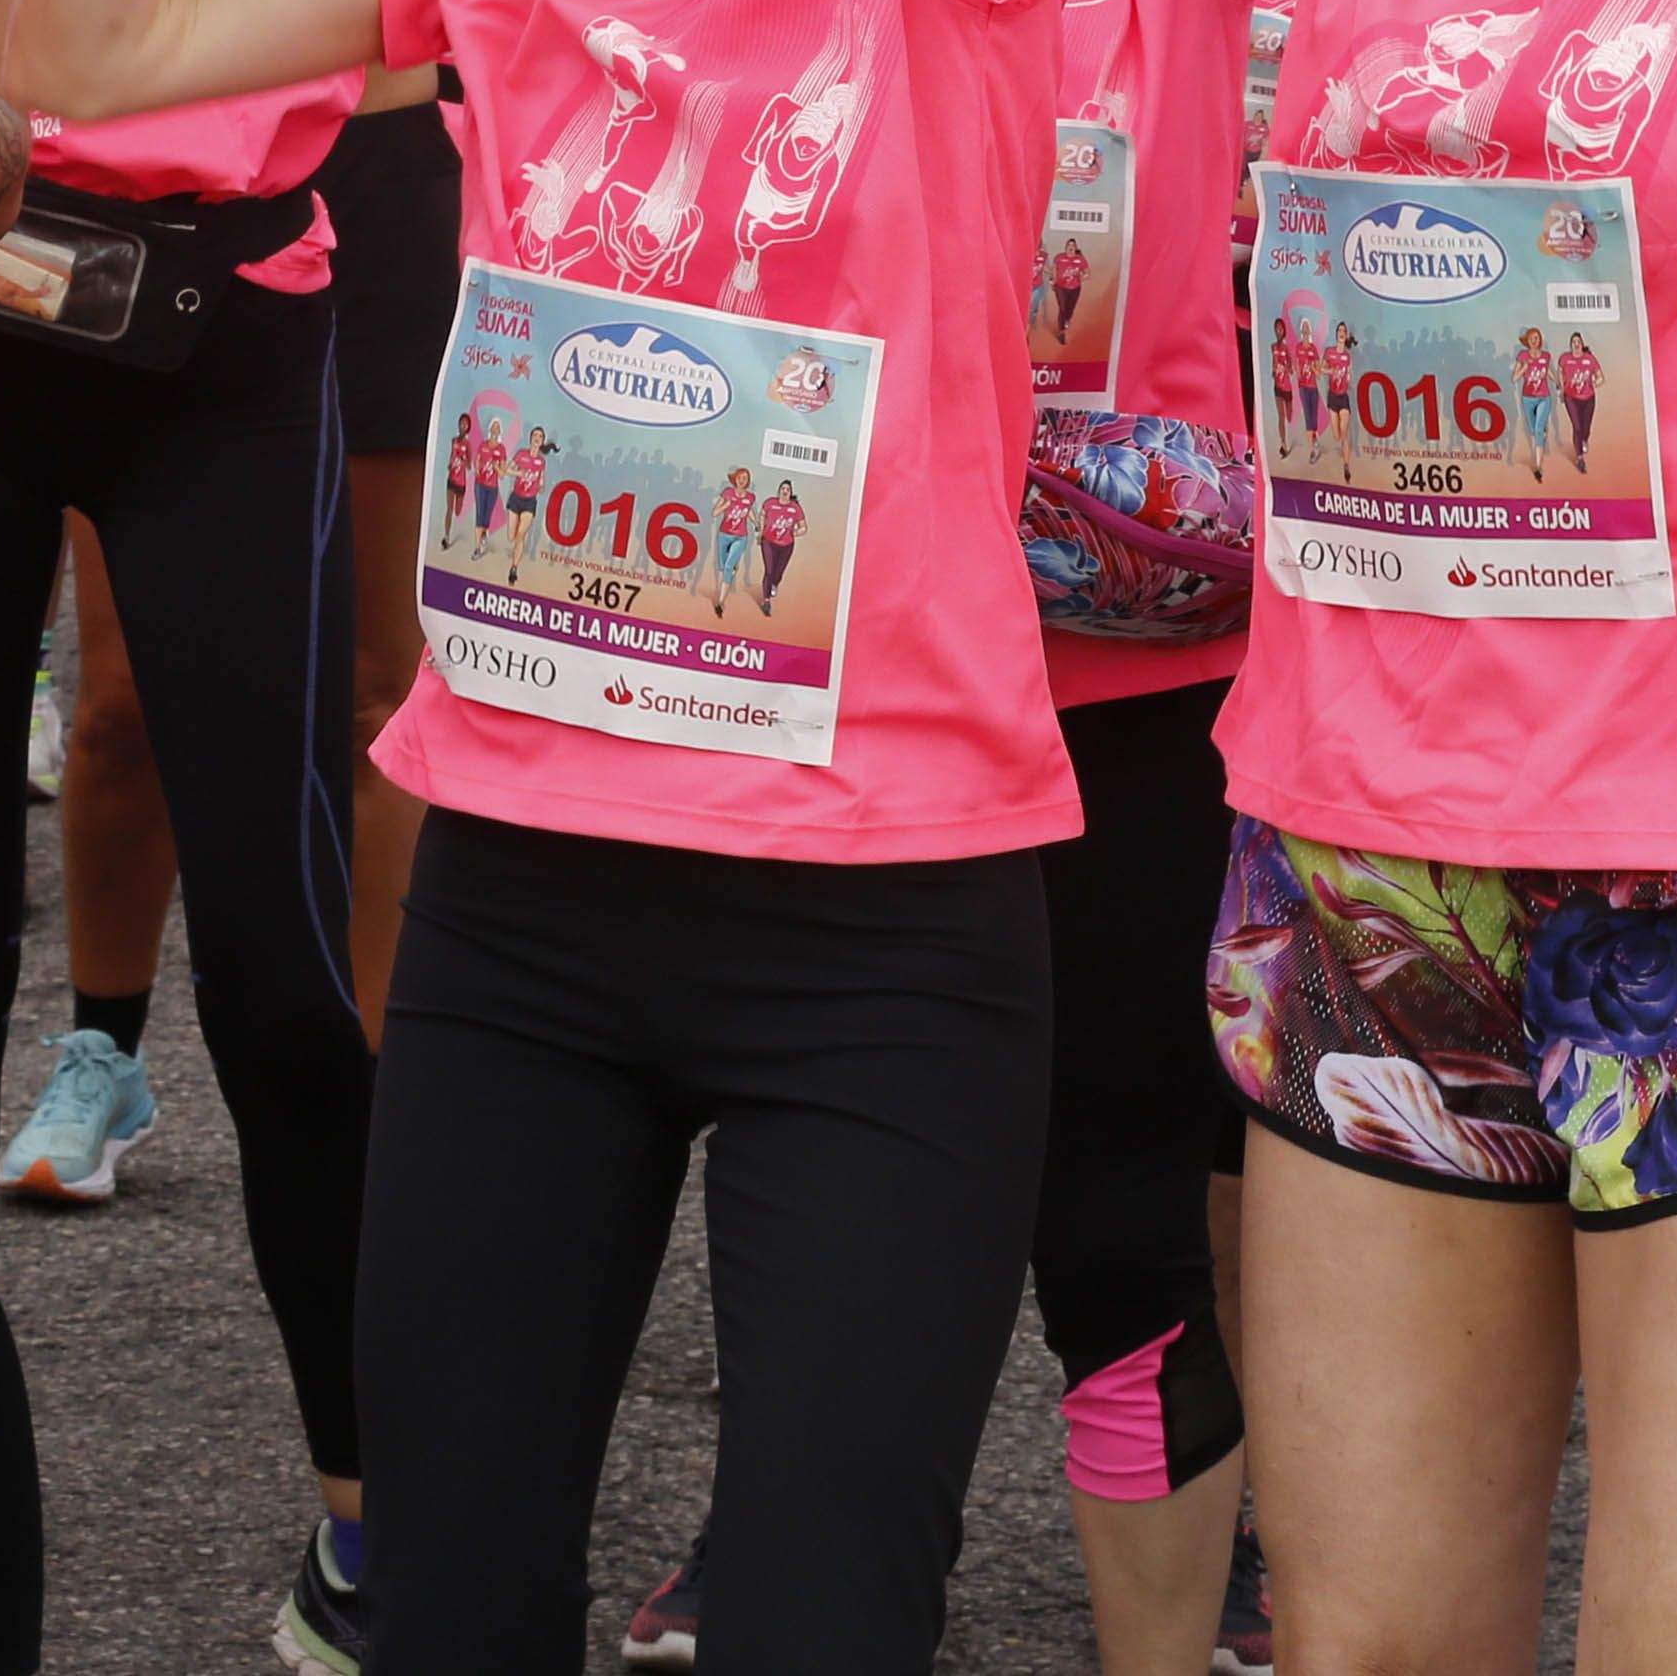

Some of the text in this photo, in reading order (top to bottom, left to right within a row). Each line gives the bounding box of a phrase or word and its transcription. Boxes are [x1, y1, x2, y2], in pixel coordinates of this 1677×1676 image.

[1278, 209, 1328, 236] SUMA
[1269, 234, 1484, 272] gijón CENTRAL LECHERA
[1351, 235, 1493, 278] ASTURIANA
[476, 309, 530, 341] SUMA
[461, 344, 503, 371] gijón
[588, 348, 645, 369] CENTRAL
[652, 361, 714, 382] LECHERA
[561, 347, 715, 412] ASTURIANA
[1356, 371, 1506, 443] 016
[1392, 461, 1463, 494] 3466
[544, 479, 701, 570] 016
[1314, 490, 1591, 530] CARRERA DE LA MUJER GIJÓN
[1299, 538, 1402, 582] OYSHO
[1481, 563, 1615, 588] Santander
[568, 573, 641, 613] 3467
[464, 587, 766, 671] CARRERA DE LA MUJER GIJÓN
[446, 633, 557, 689] OYSHO
[638, 686, 779, 728] Santander
